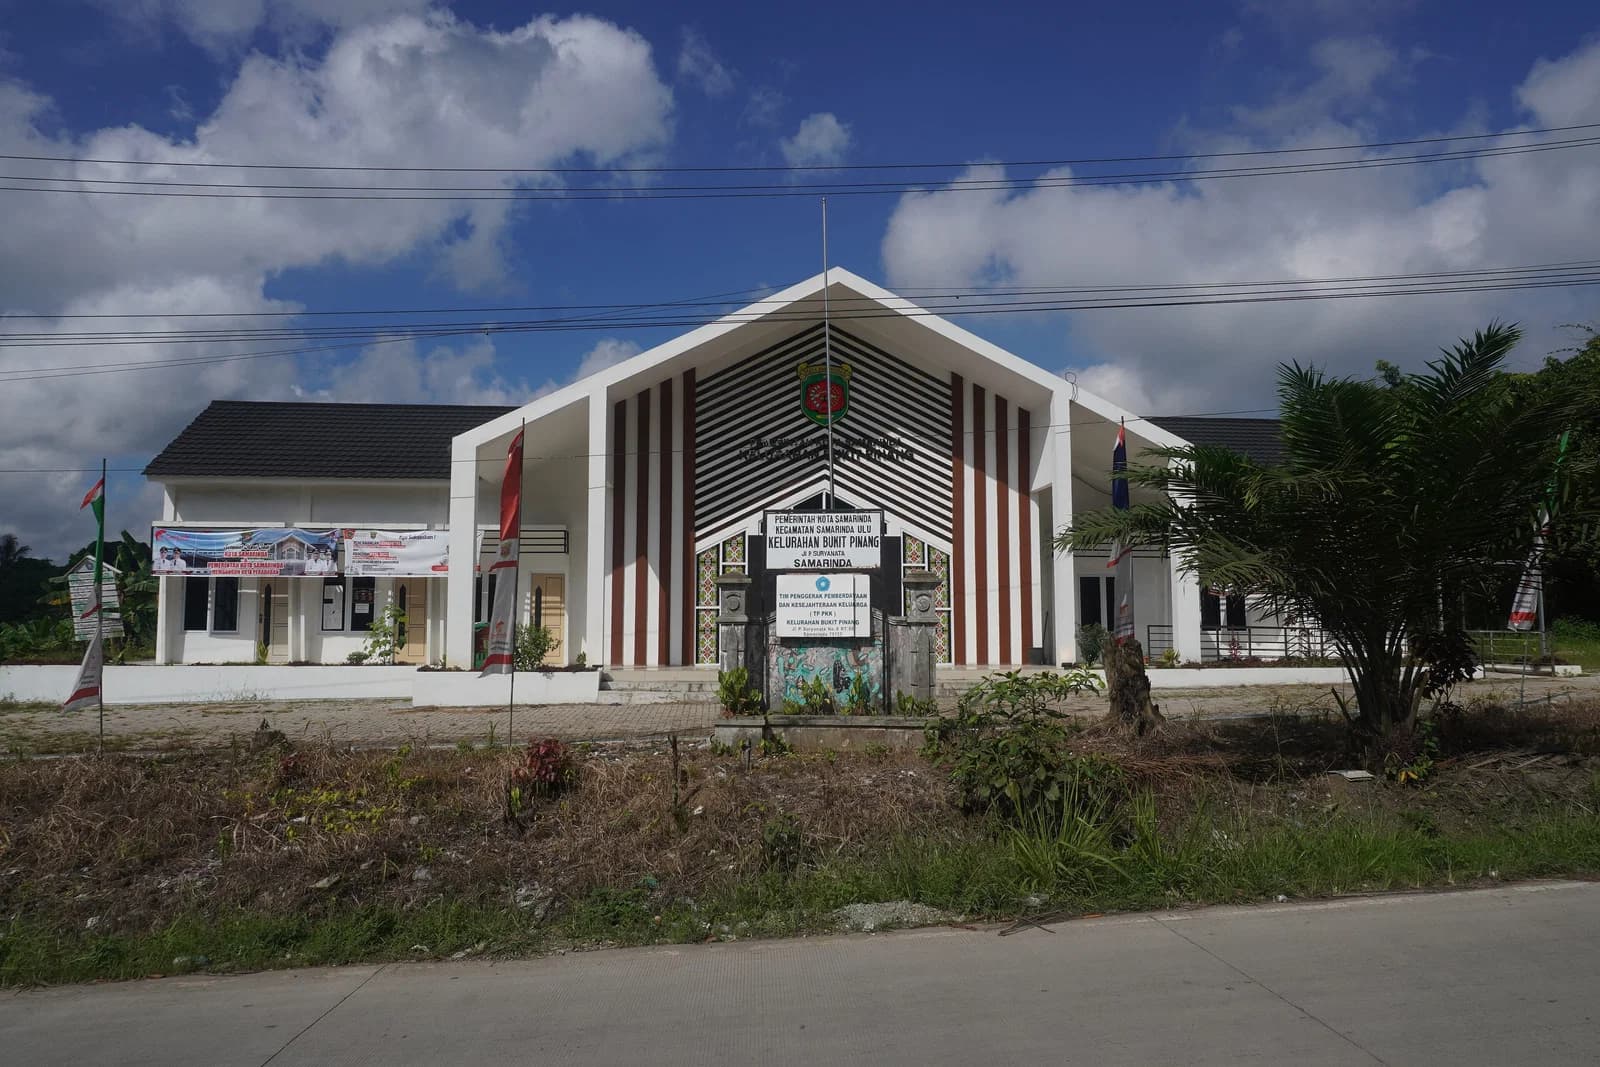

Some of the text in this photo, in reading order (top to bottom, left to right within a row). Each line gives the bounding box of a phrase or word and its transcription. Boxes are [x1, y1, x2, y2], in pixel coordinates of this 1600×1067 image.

[775, 515, 872, 524] PEMERINTAH KOTA SAMARINDA
[775, 525, 872, 535] KECAMATAN SAMARINDA ULU
[768, 536, 879, 549] KELURAHAN BUKIT PINANG
[794, 558, 852, 568] SAMARINDA
